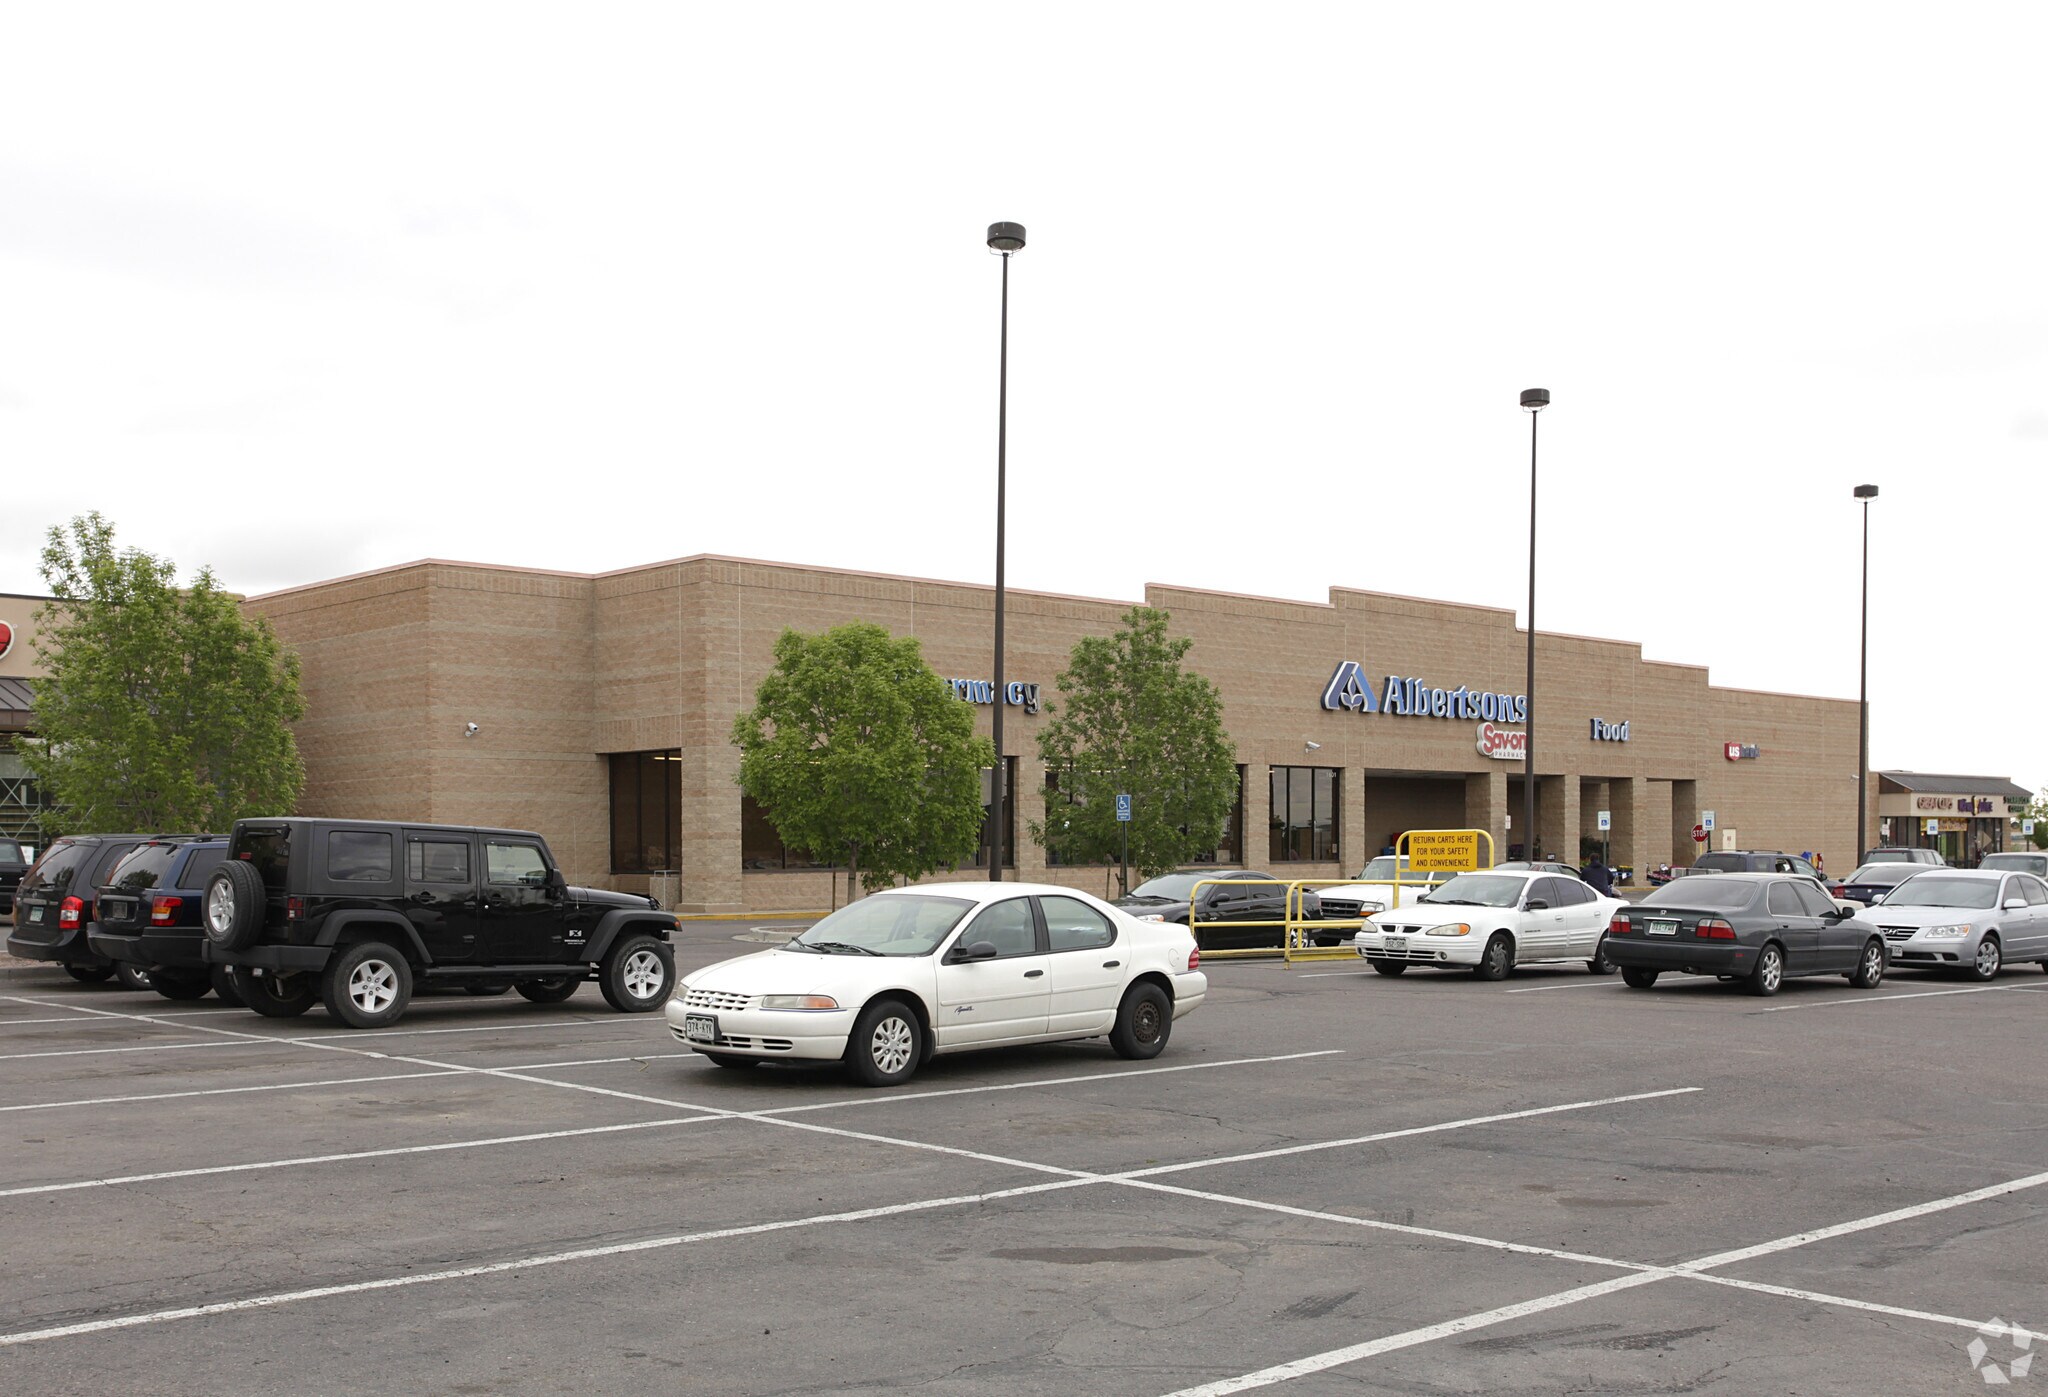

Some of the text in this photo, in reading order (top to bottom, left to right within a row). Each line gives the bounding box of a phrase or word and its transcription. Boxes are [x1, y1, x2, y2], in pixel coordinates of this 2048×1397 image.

[1380, 676, 1527, 722] Albertsons
[1591, 718, 1630, 742] Food
[1692, 830, 1708, 838] STOP
[1413, 836, 1435, 844] RETURN
[1457, 835, 1473, 843] HERE
[1447, 847, 1469, 855] SAFETY
[1416, 859, 1469, 867] AND CONVENIENCE
